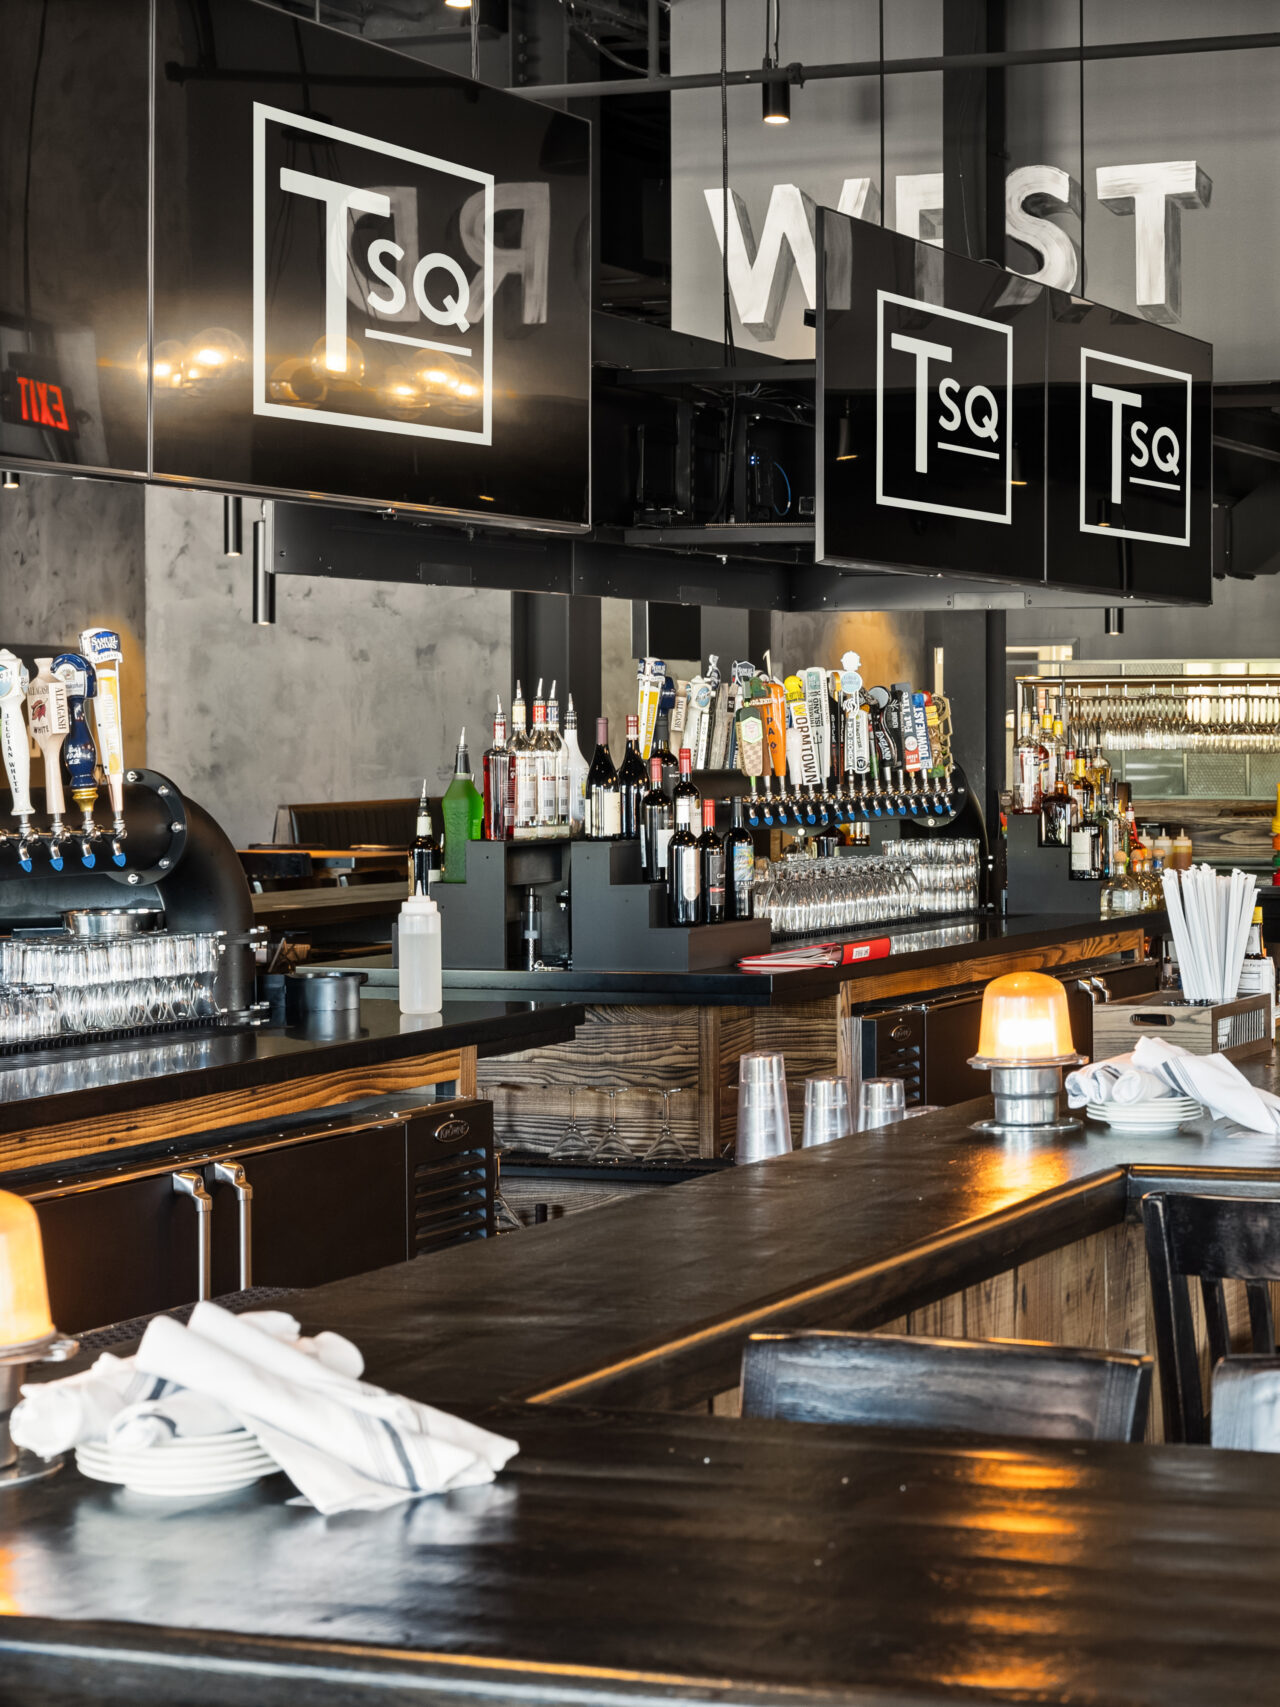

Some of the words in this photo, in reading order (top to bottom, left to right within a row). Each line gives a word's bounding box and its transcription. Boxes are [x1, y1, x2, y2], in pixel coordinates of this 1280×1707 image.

[92, 635, 118, 646] SAMUEL
[55, 687, 67, 730] ALLAGASH
[813, 698, 821, 727] ISLAND
[901, 691, 910, 714] Tire
[33, 725, 49, 734] WHITE
[904, 714, 913, 733] Fat
[913, 706, 929, 757] DOWNEAST
[792, 703, 818, 784] WORMTOWN
